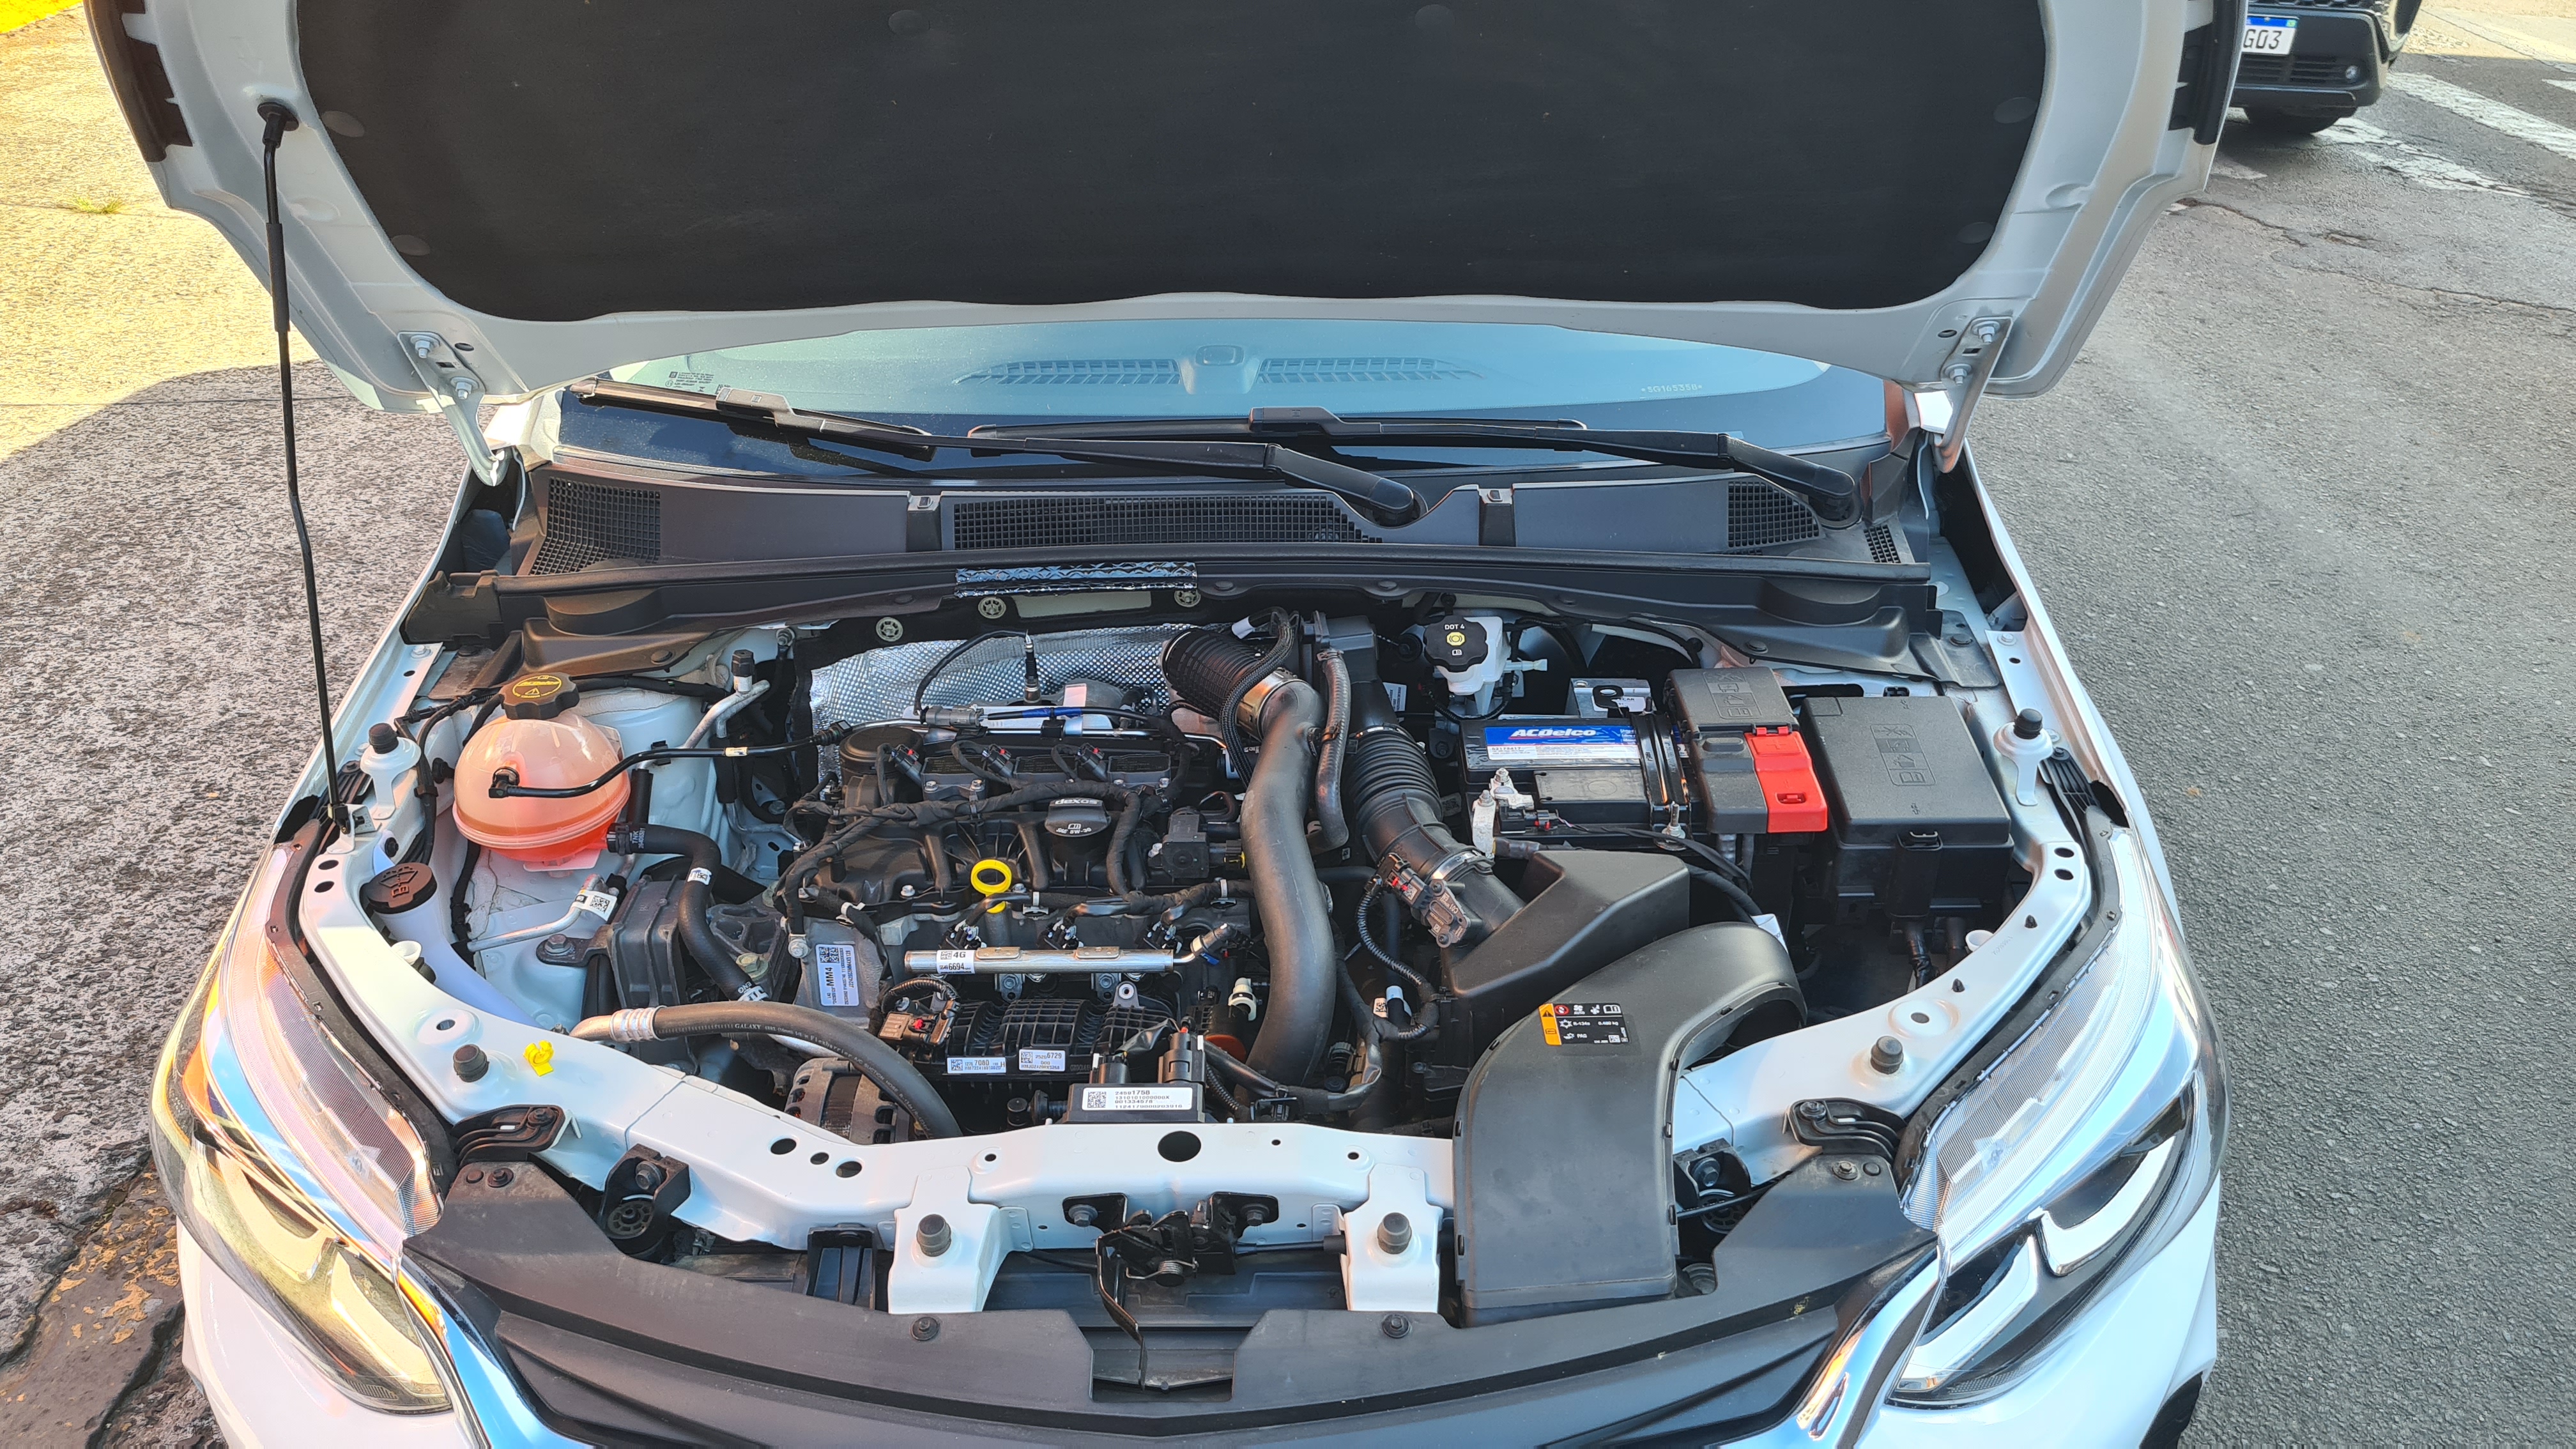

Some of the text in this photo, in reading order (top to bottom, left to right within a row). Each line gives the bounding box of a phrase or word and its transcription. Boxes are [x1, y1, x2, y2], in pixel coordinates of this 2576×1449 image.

[1510, 728, 1597, 737] ACDelco
[825, 967, 834, 986] MM4
[864, 1062, 885, 1081] SUCTION
[885, 1079, 899, 1093] HOSE
